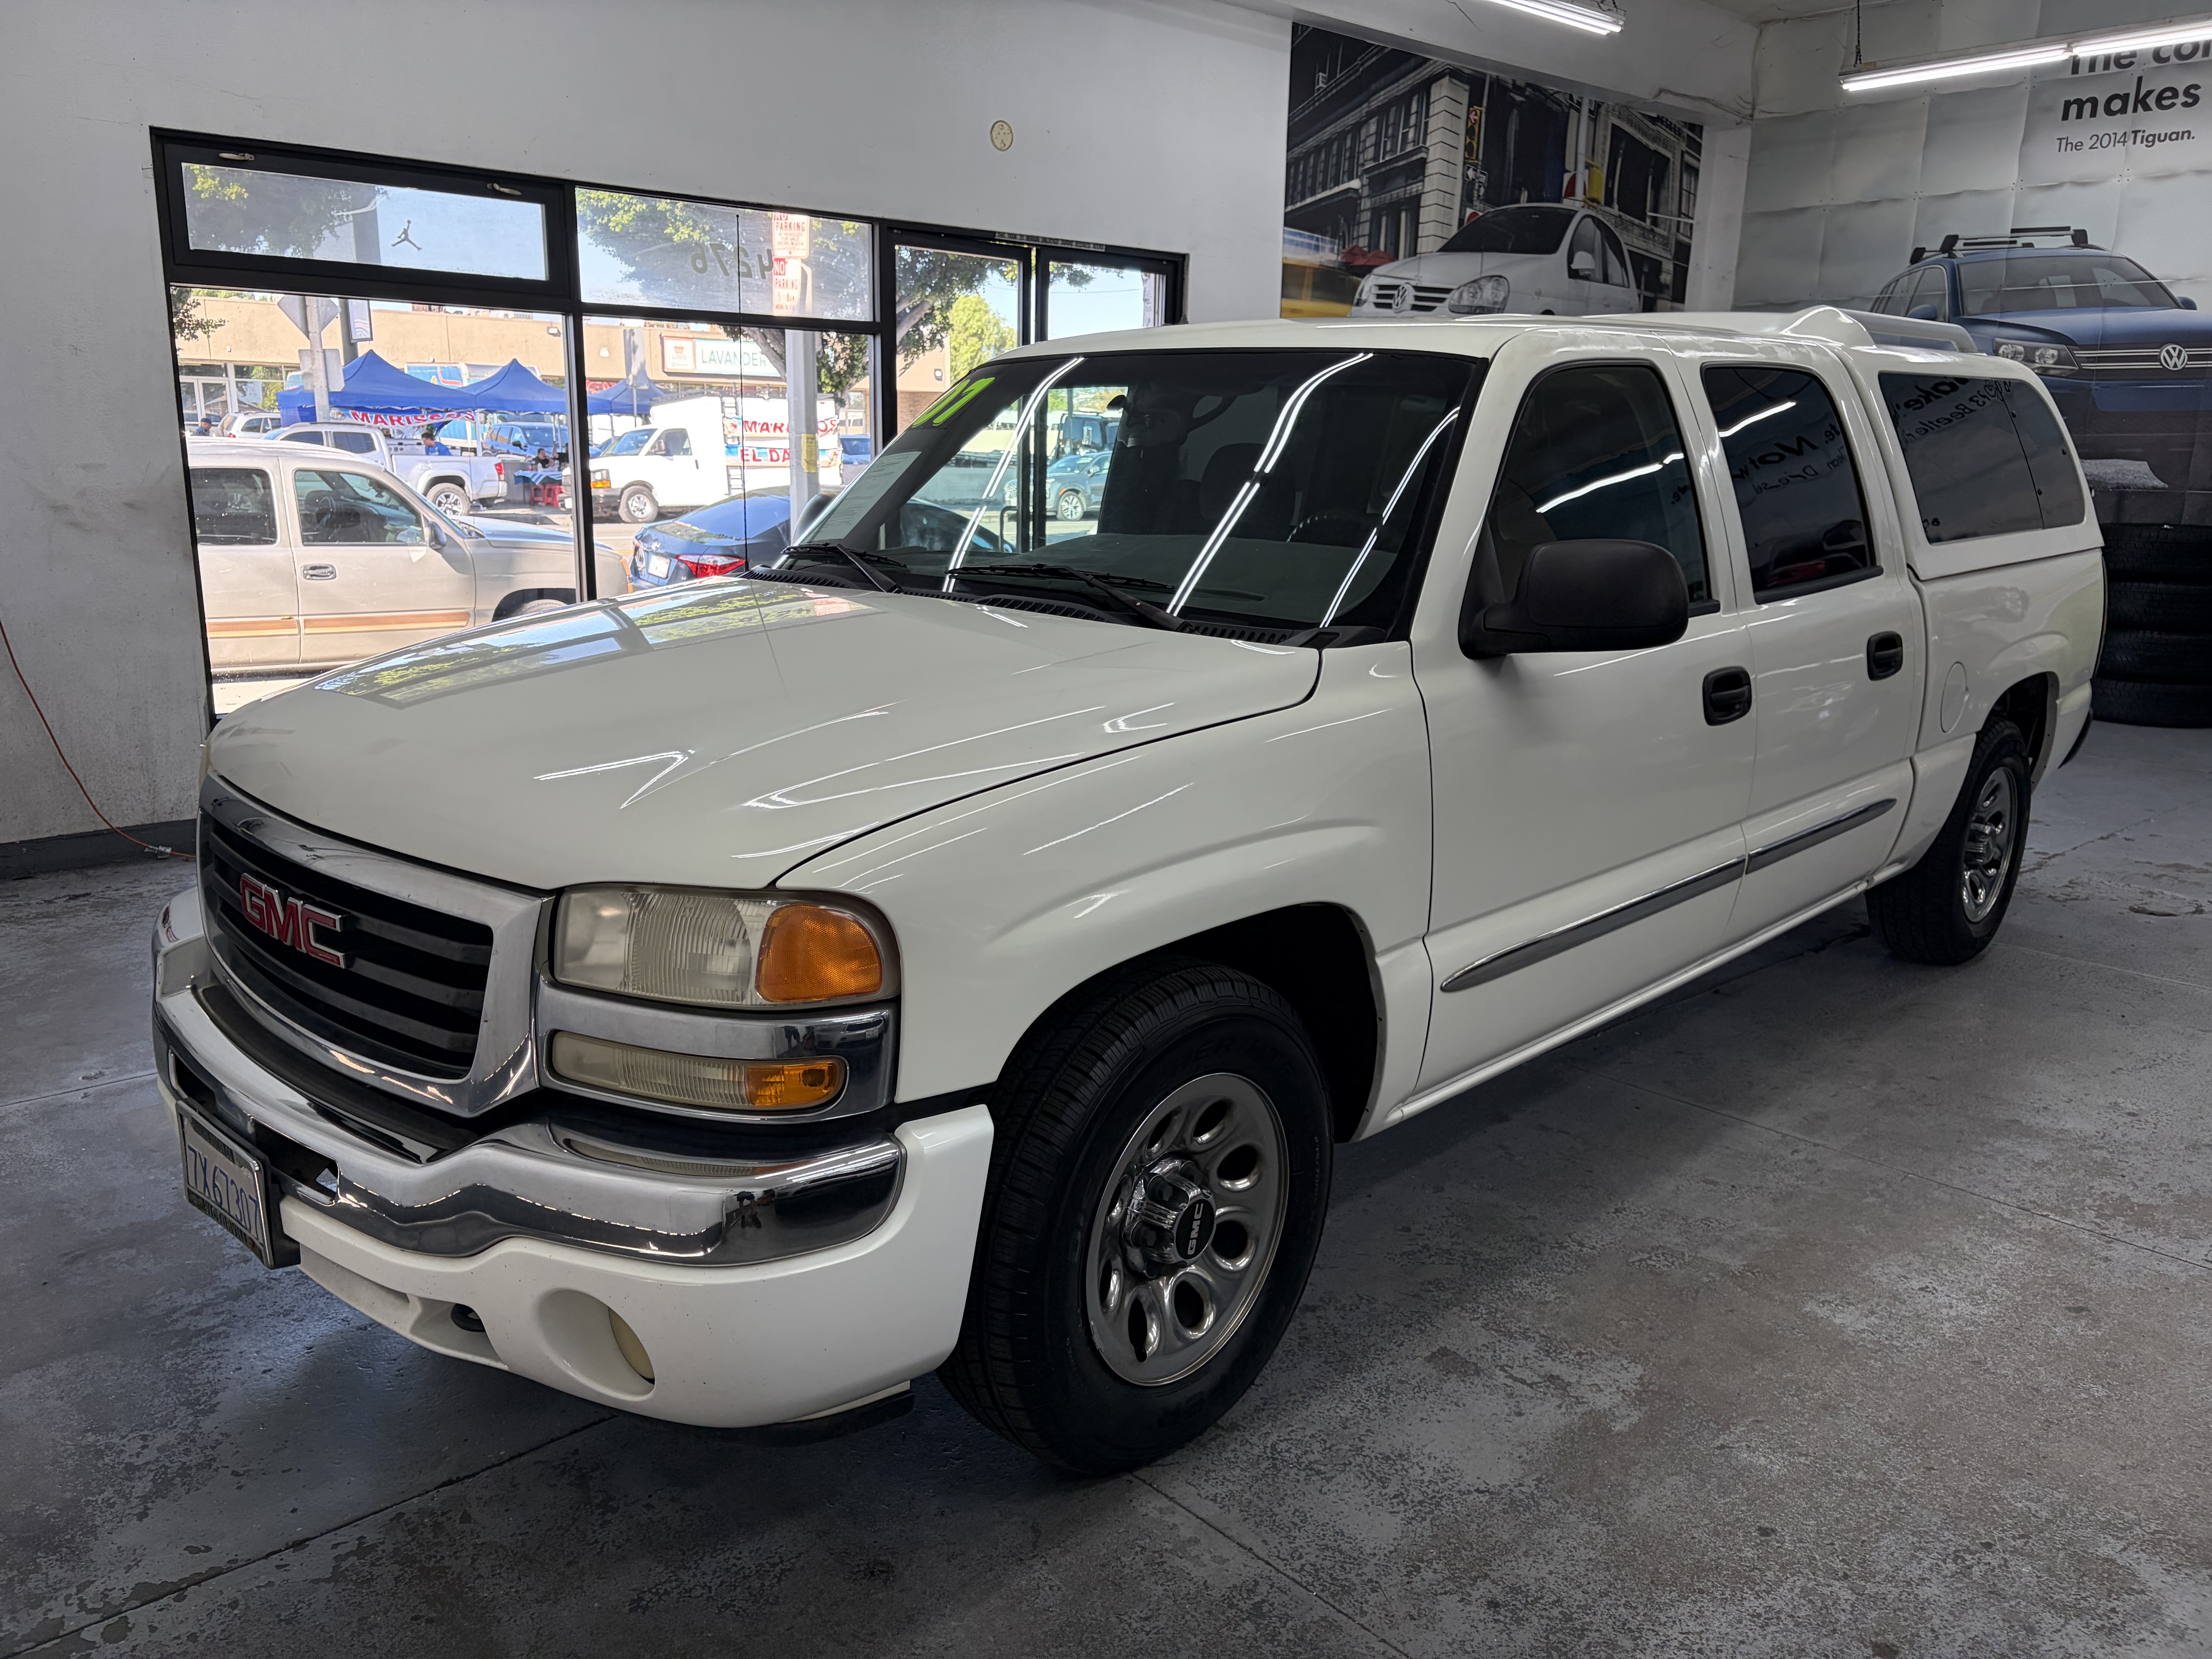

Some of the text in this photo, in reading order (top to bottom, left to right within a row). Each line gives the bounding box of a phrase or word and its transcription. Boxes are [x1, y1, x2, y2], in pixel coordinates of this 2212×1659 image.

[2061, 76, 2202, 122] makes
[2057, 129, 2195, 153] The 2014 Tiguan.
[775, 212, 788, 220] NO
[776, 222, 805, 232] PARKING
[775, 260, 785, 275] NO
[776, 278, 798, 290] PARKING
[702, 349, 771, 366] LAVANDER
[350, 410, 475, 426] MARISCOS
[740, 449, 762, 462] EL
[240, 872, 347, 969] GMC
[1187, 1203, 1204, 1255] GMC
